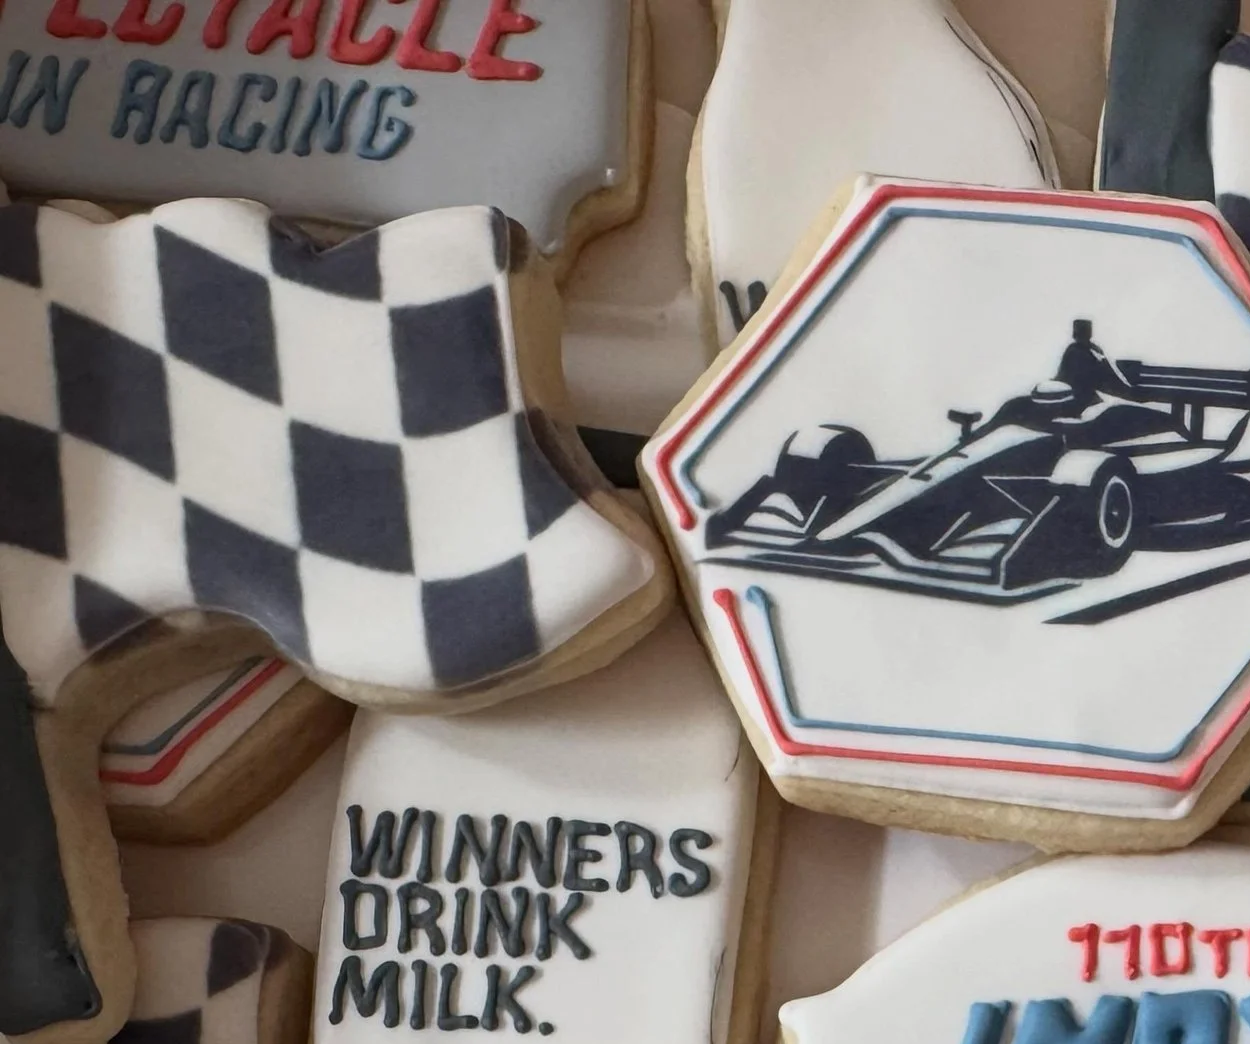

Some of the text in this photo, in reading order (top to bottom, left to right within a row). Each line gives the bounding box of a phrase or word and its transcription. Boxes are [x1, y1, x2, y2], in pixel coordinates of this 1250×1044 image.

[0, 50, 416, 161] IN RACING
[345, 804, 714, 899] WINNERS
[339, 879, 593, 961] DRINK
[328, 955, 555, 1036] MILK.
